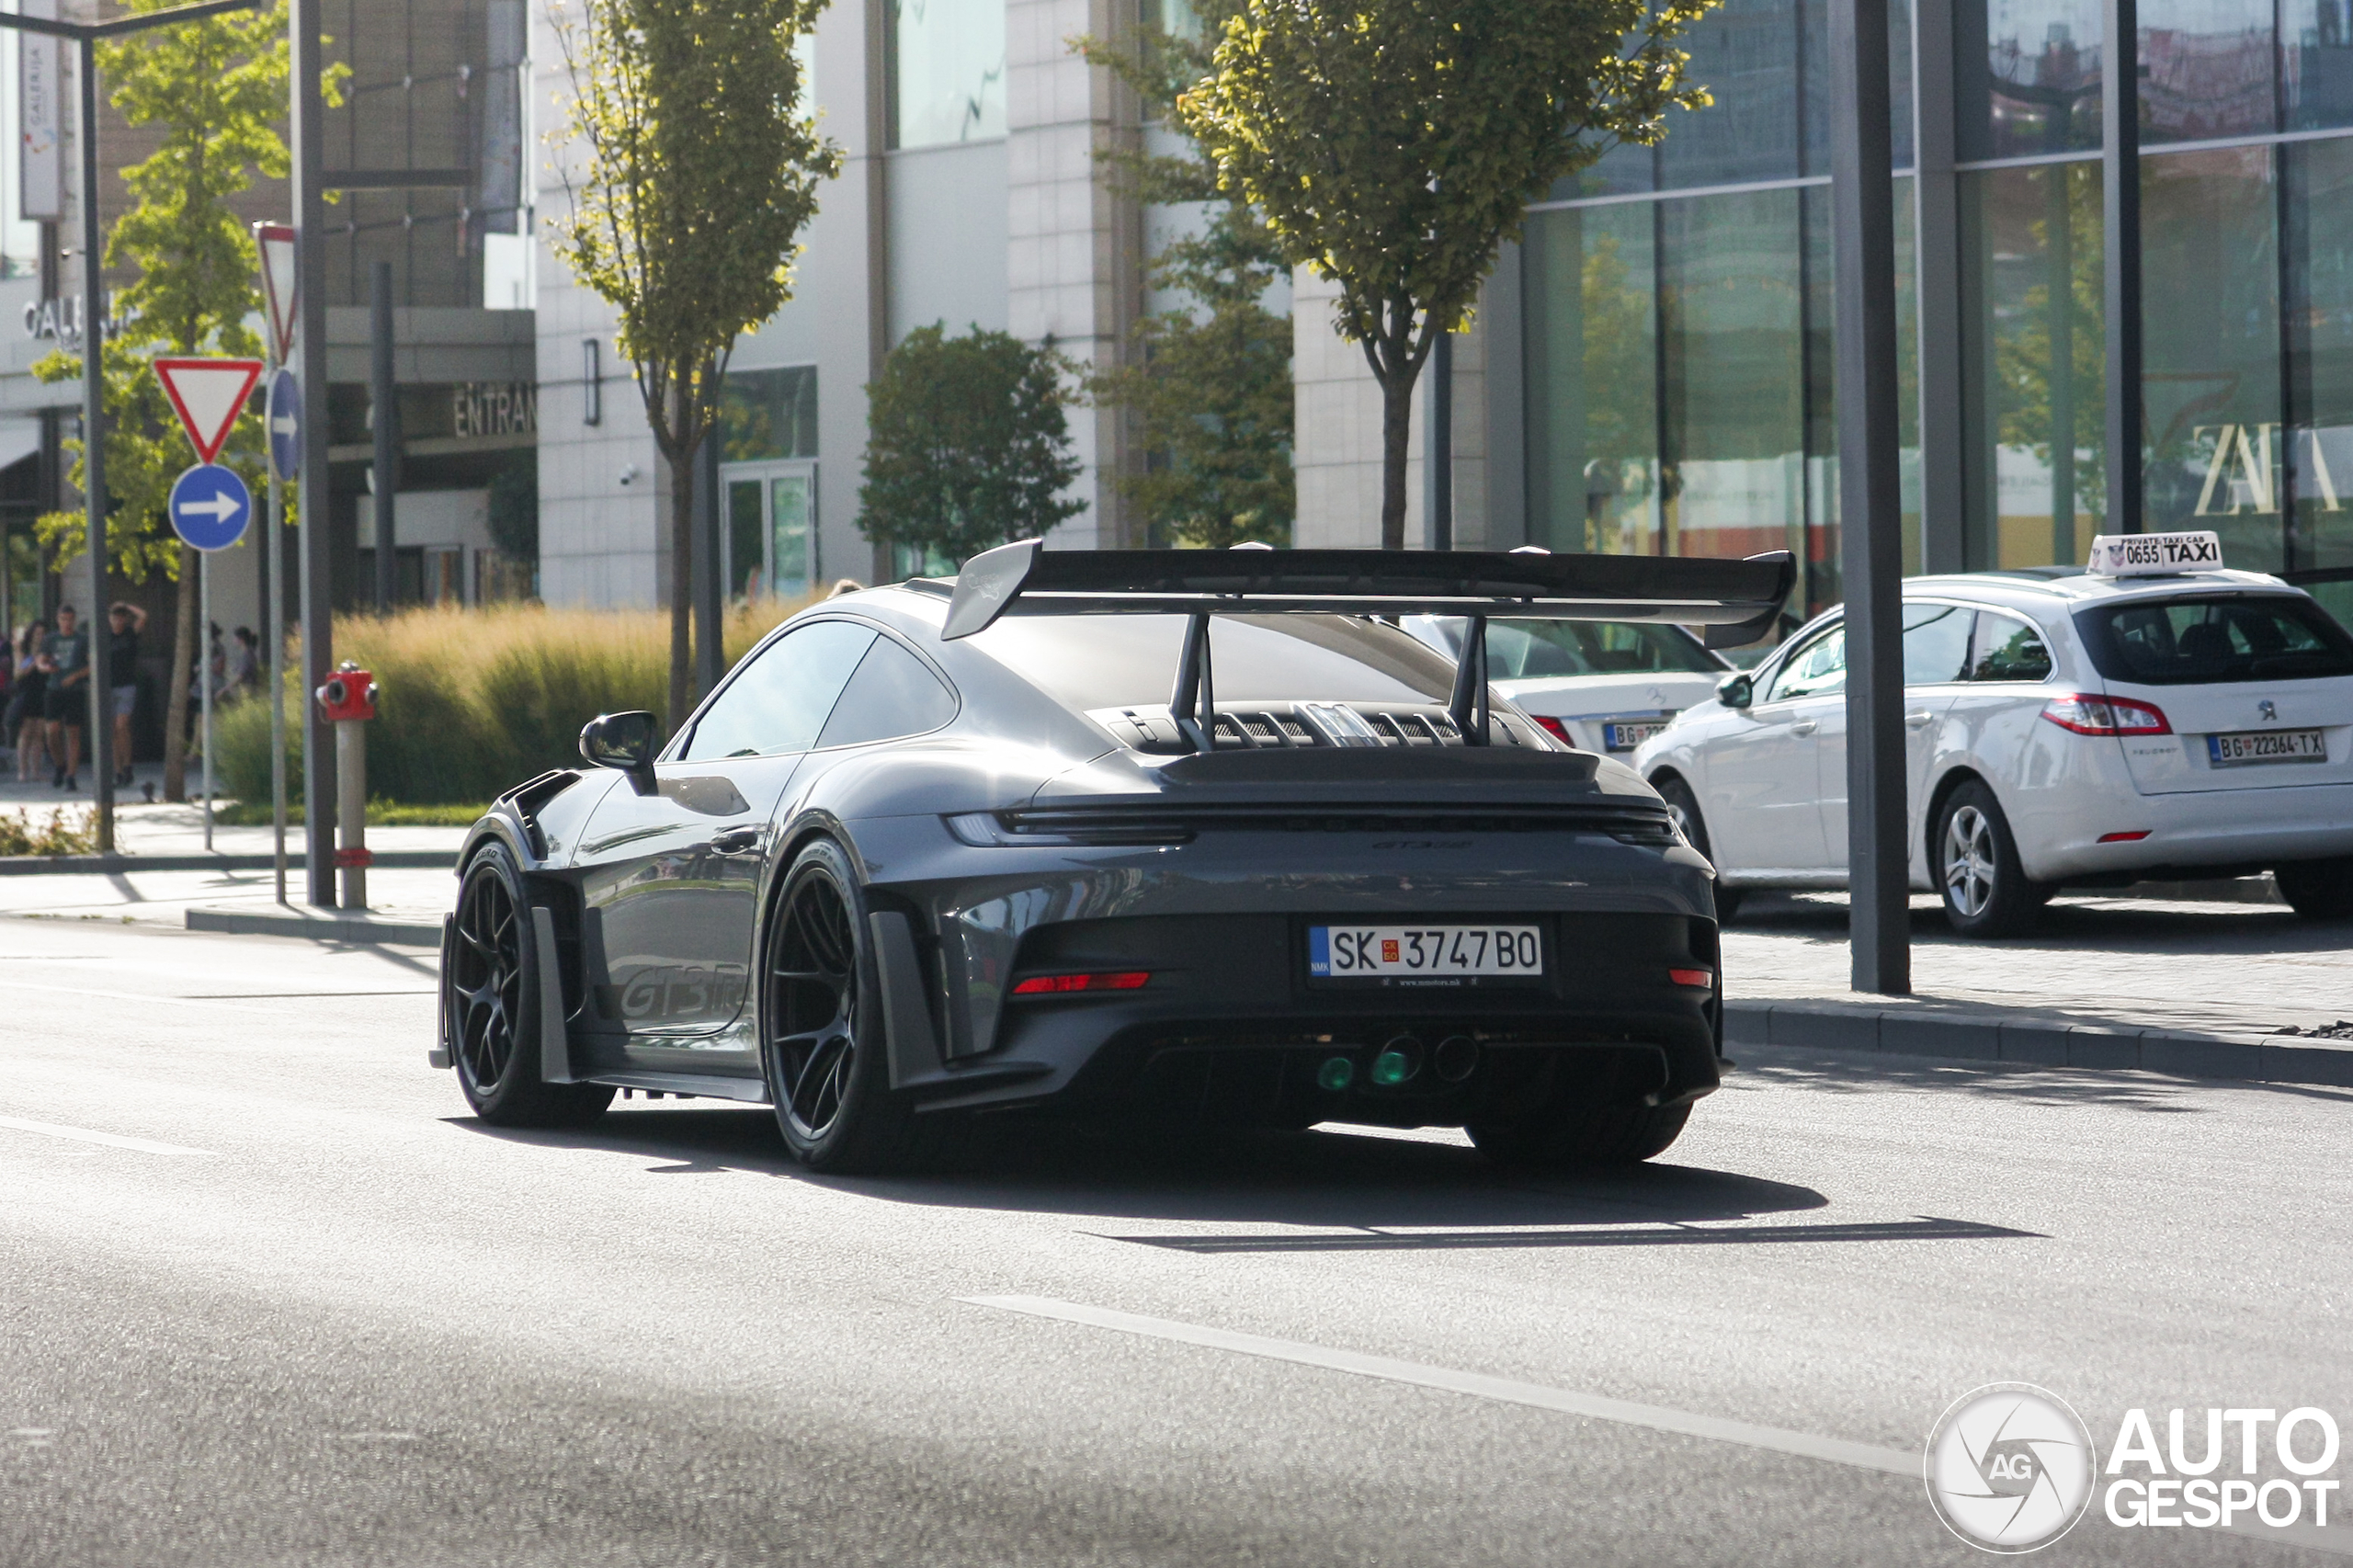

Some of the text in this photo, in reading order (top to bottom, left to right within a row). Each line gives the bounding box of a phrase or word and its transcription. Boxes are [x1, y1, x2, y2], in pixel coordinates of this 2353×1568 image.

[2121, 538, 2160, 546] PRIVATE
[2126, 543, 2217, 563] 0655 TAXI
[1616, 726, 1636, 744] BG
[2221, 737, 2243, 758] BG
[1334, 932, 1377, 970] SK
[1310, 962, 1329, 972] NMK
